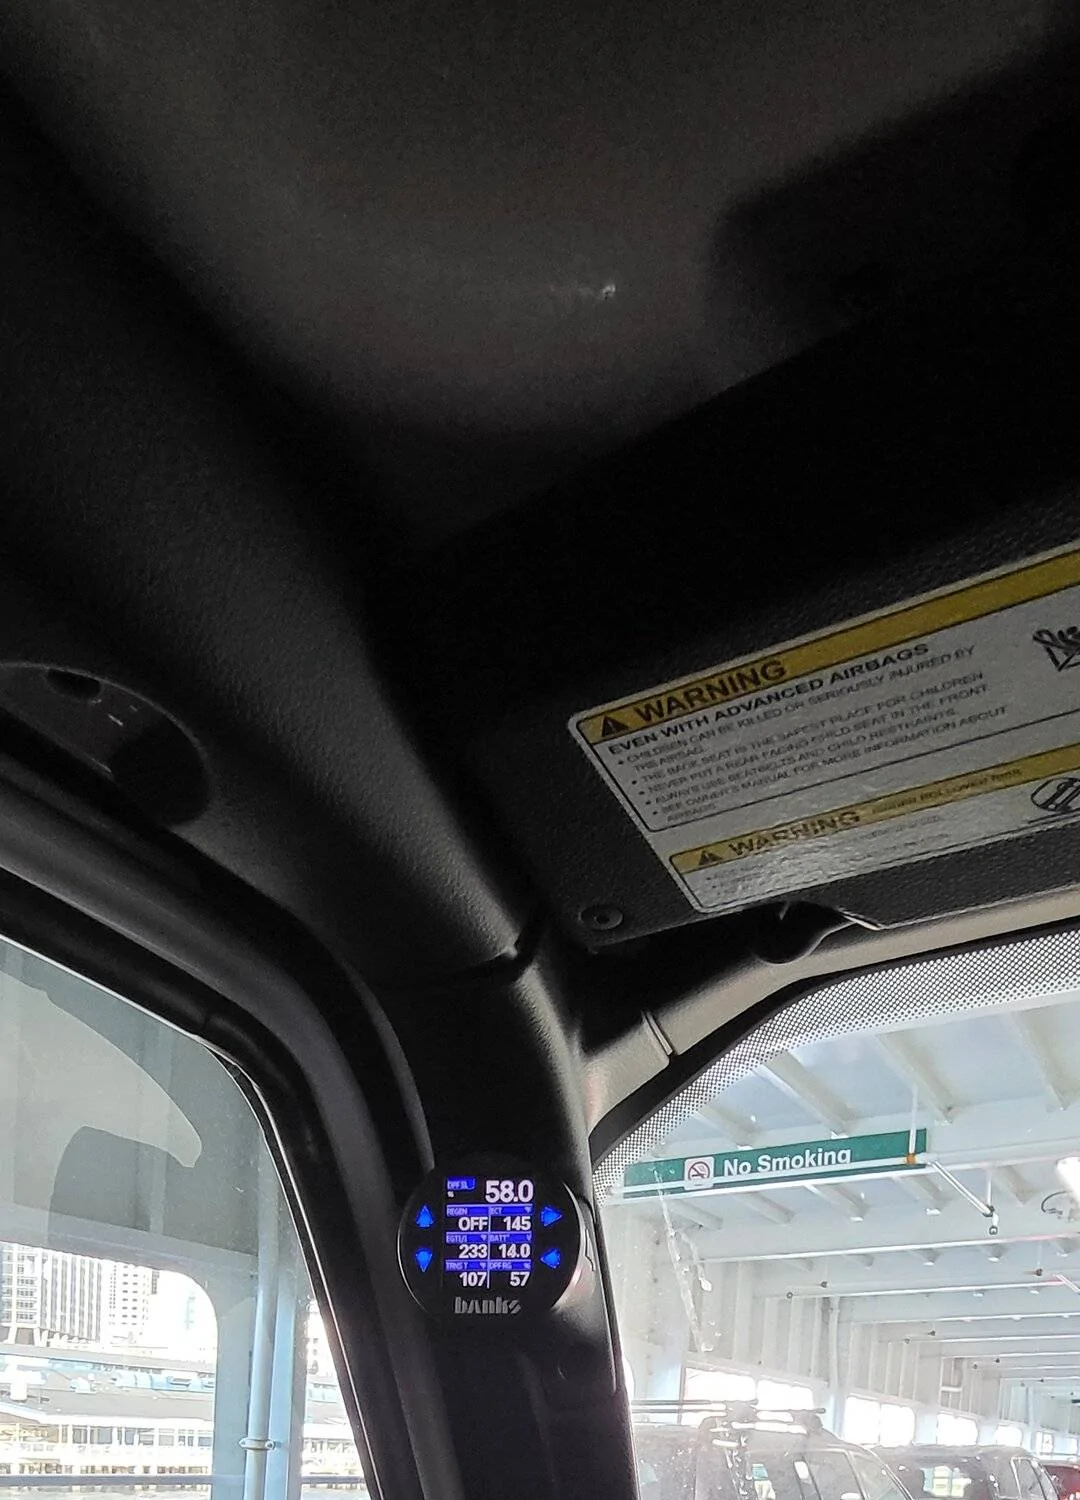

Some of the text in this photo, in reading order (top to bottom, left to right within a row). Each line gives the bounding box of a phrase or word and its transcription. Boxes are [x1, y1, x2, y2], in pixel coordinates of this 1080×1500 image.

[633, 659, 788, 723] WARNING
[690, 729, 716, 743] CAN
[737, 708, 782, 729] KILLED
[785, 700, 804, 713] OR
[808, 674, 884, 705] SERIOUSLY
[888, 653, 952, 681] INJURED
[954, 644, 976, 659] BY
[910, 671, 983, 700] CHILDREN
[608, 643, 929, 755] EVEN WITH ADVANCED AIRBAGS
[728, 810, 861, 856] WARNING
[724, 1148, 851, 1177] No Smoking
[485, 1179, 534, 1203] 58.0
[458, 1216, 488, 1231] OFF
[503, 1215, 532, 1231] 145
[458, 1243, 488, 1259] 233
[498, 1243, 531, 1259] 14.0
[459, 1271, 488, 1287] 107
[509, 1271, 531, 1287] 57
